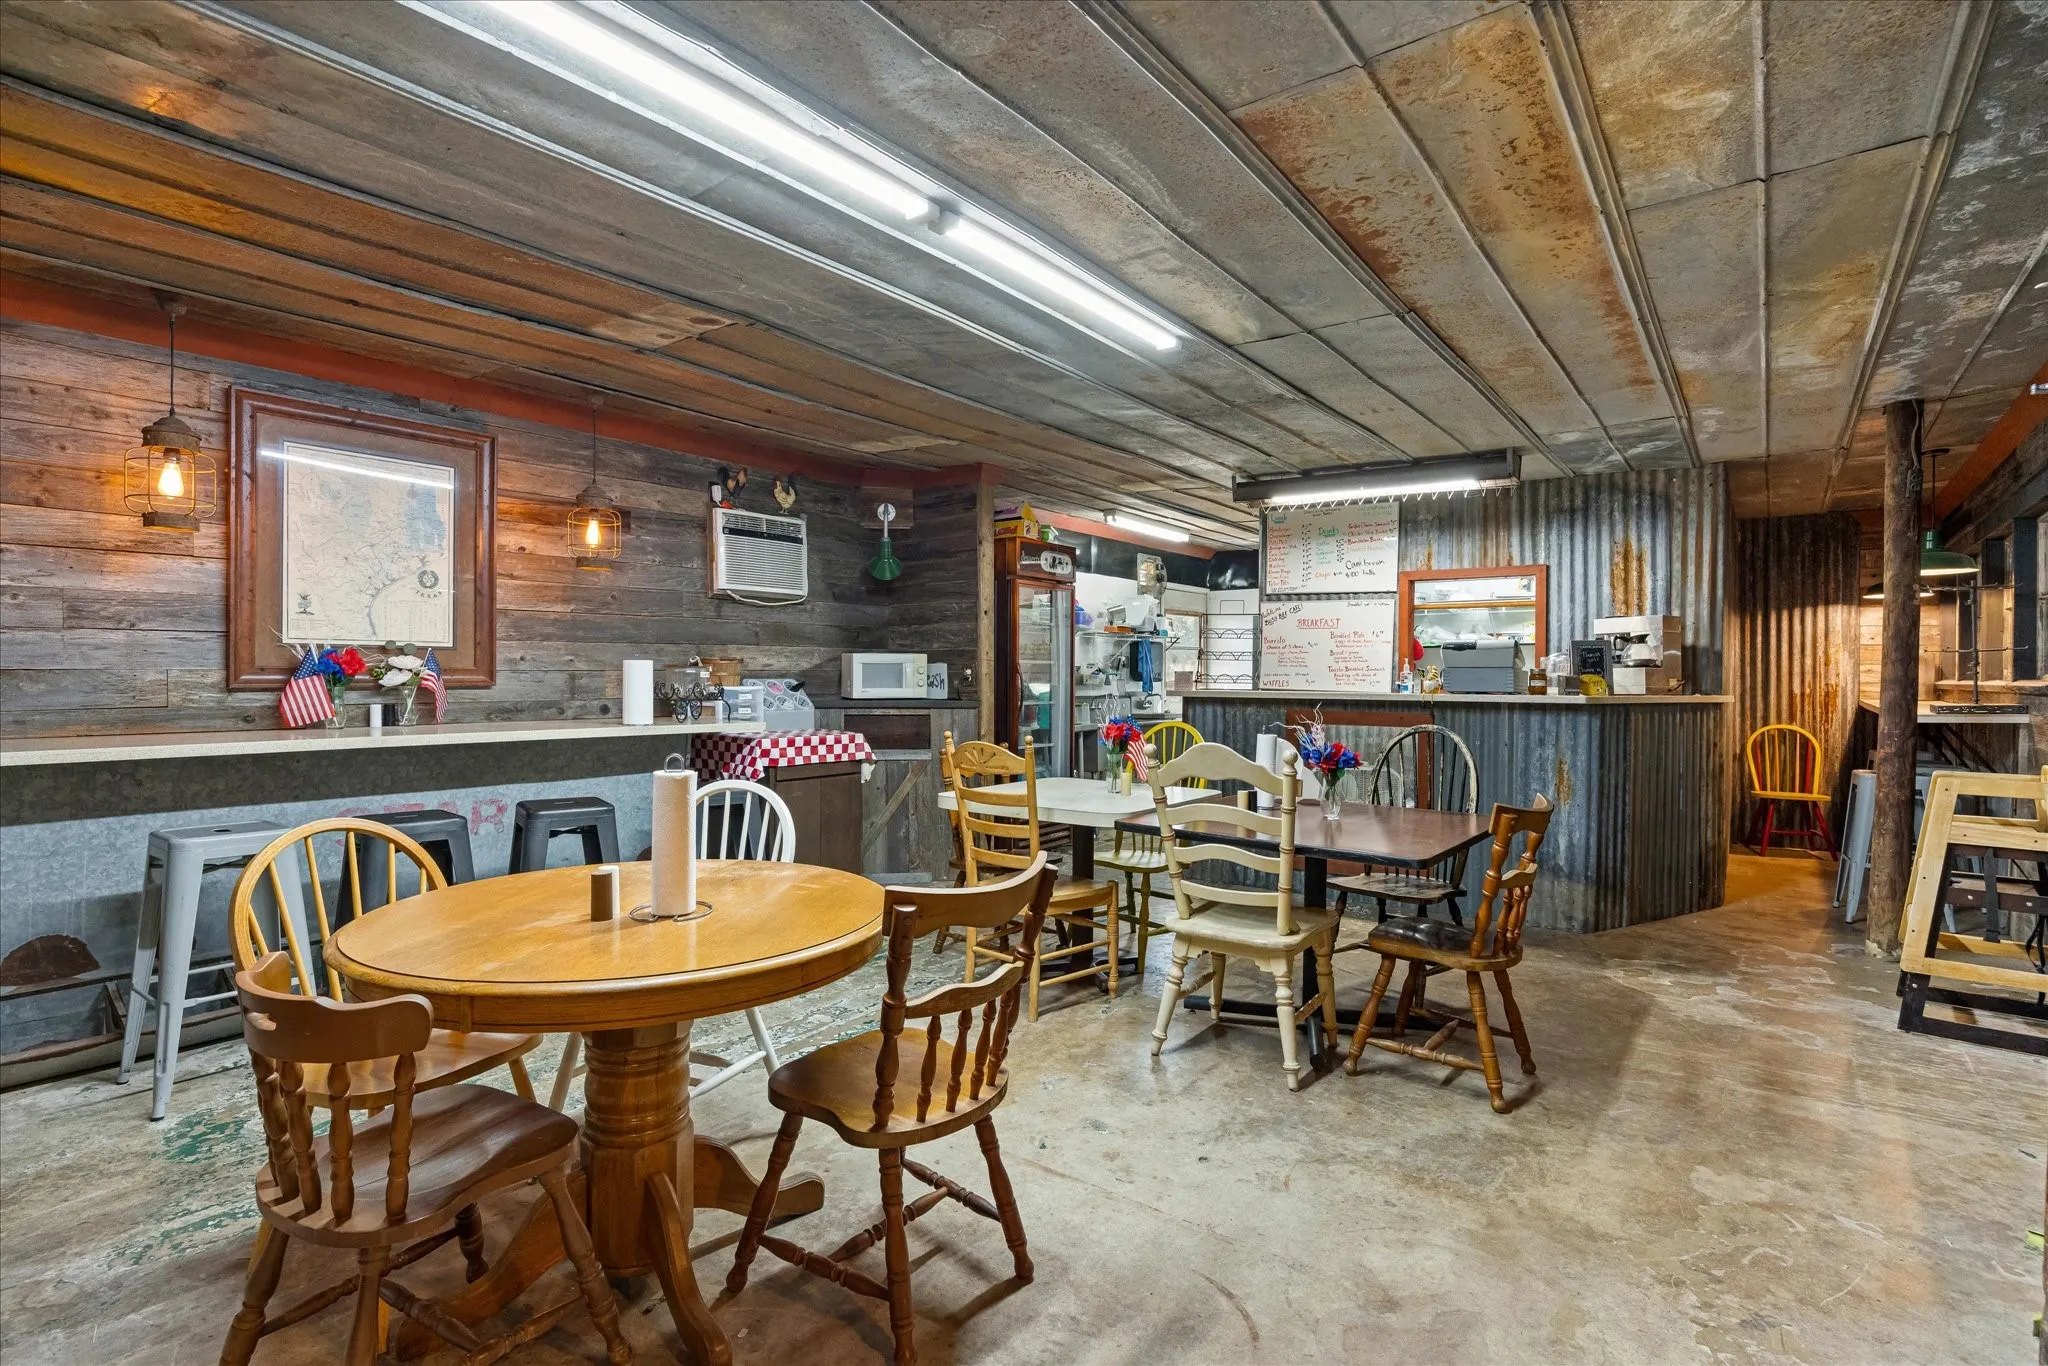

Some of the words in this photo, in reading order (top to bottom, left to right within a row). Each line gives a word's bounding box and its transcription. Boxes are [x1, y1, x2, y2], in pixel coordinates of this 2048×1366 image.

[1270, 513, 1288, 522] Lunch
[1318, 526, 1340, 536] Drinks
[416, 590, 442, 599] TEXAS
[1297, 618, 1341, 628] BREAKFAST
